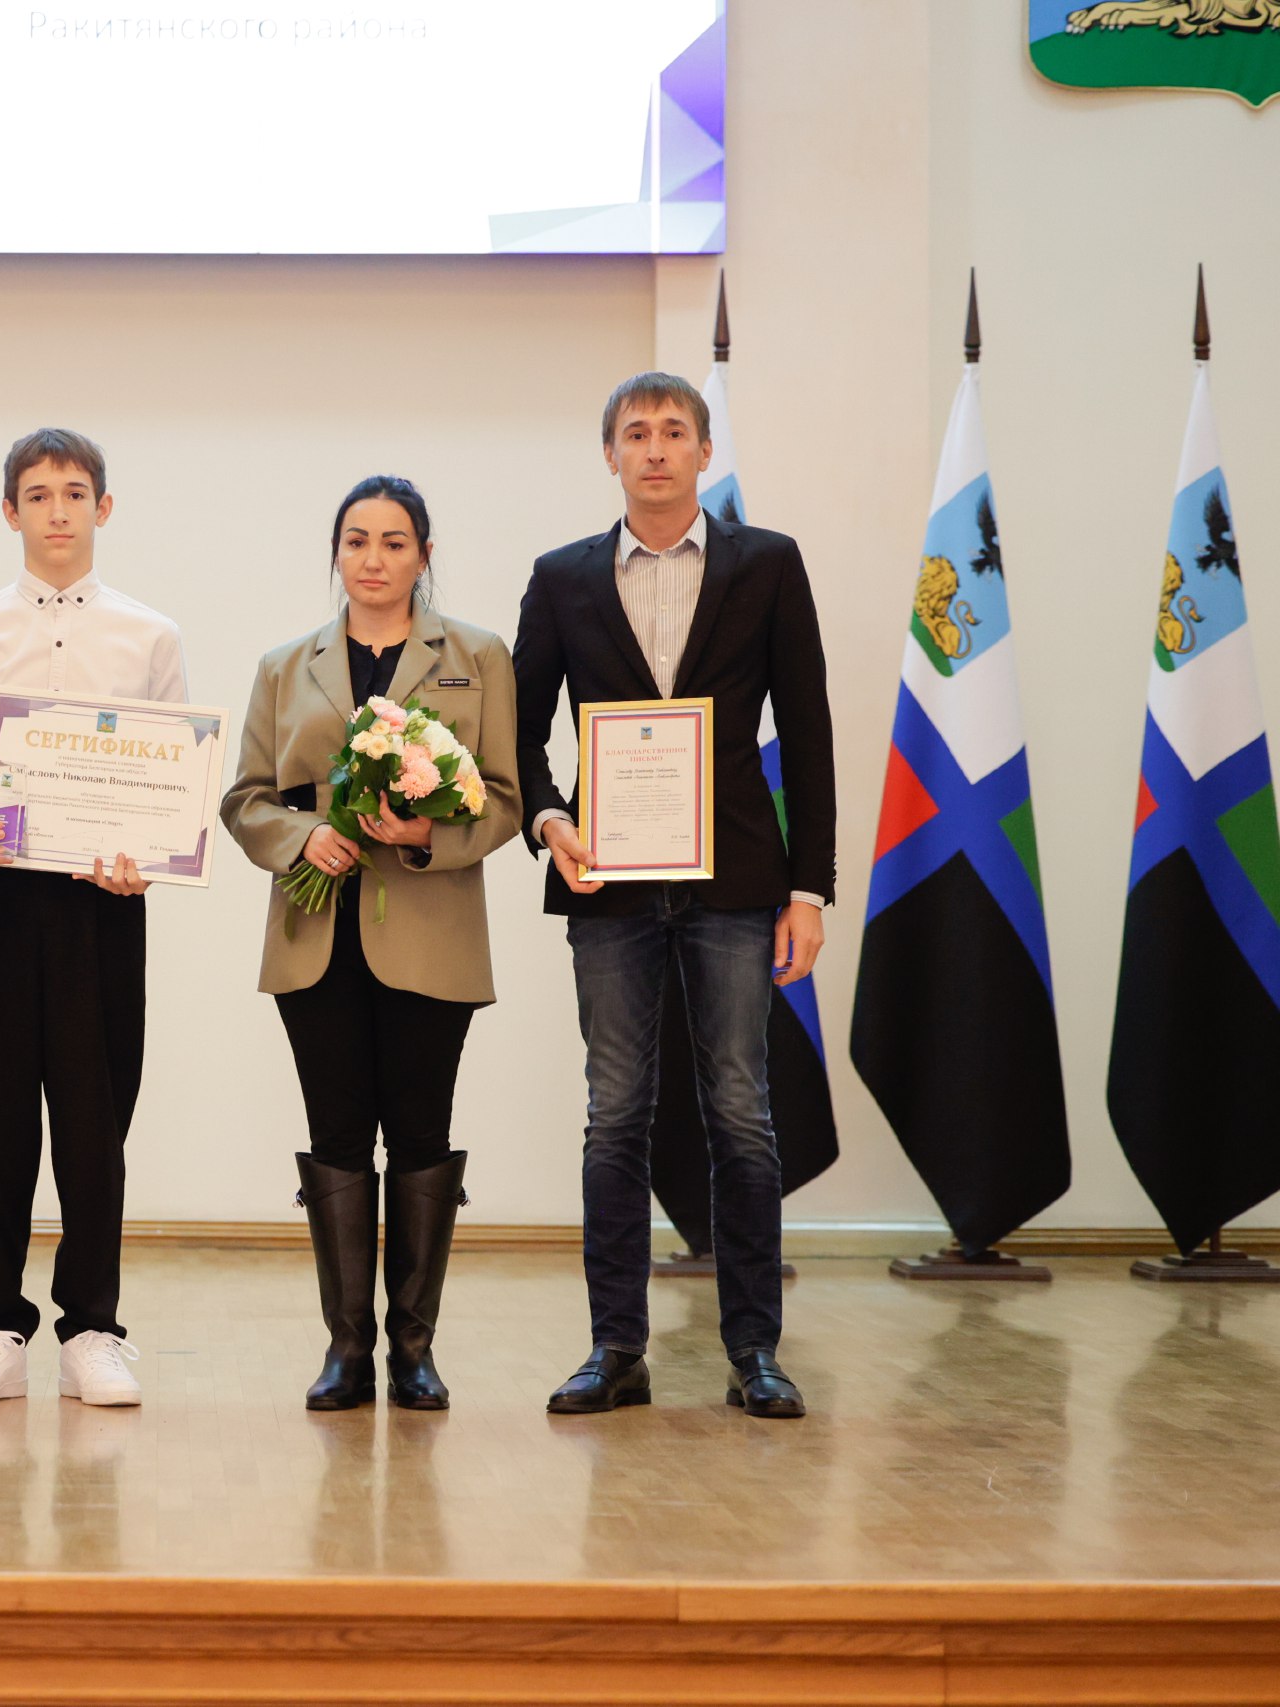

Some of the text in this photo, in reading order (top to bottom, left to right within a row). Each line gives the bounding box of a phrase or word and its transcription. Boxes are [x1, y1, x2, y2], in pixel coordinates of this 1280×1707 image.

[29, 9, 428, 47] Ракитянского района
[24, 729, 185, 762] СЕРТИФИКАТ
[62, 771, 107, 785] Николаю
[108, 776, 190, 793] Владимировичу.
